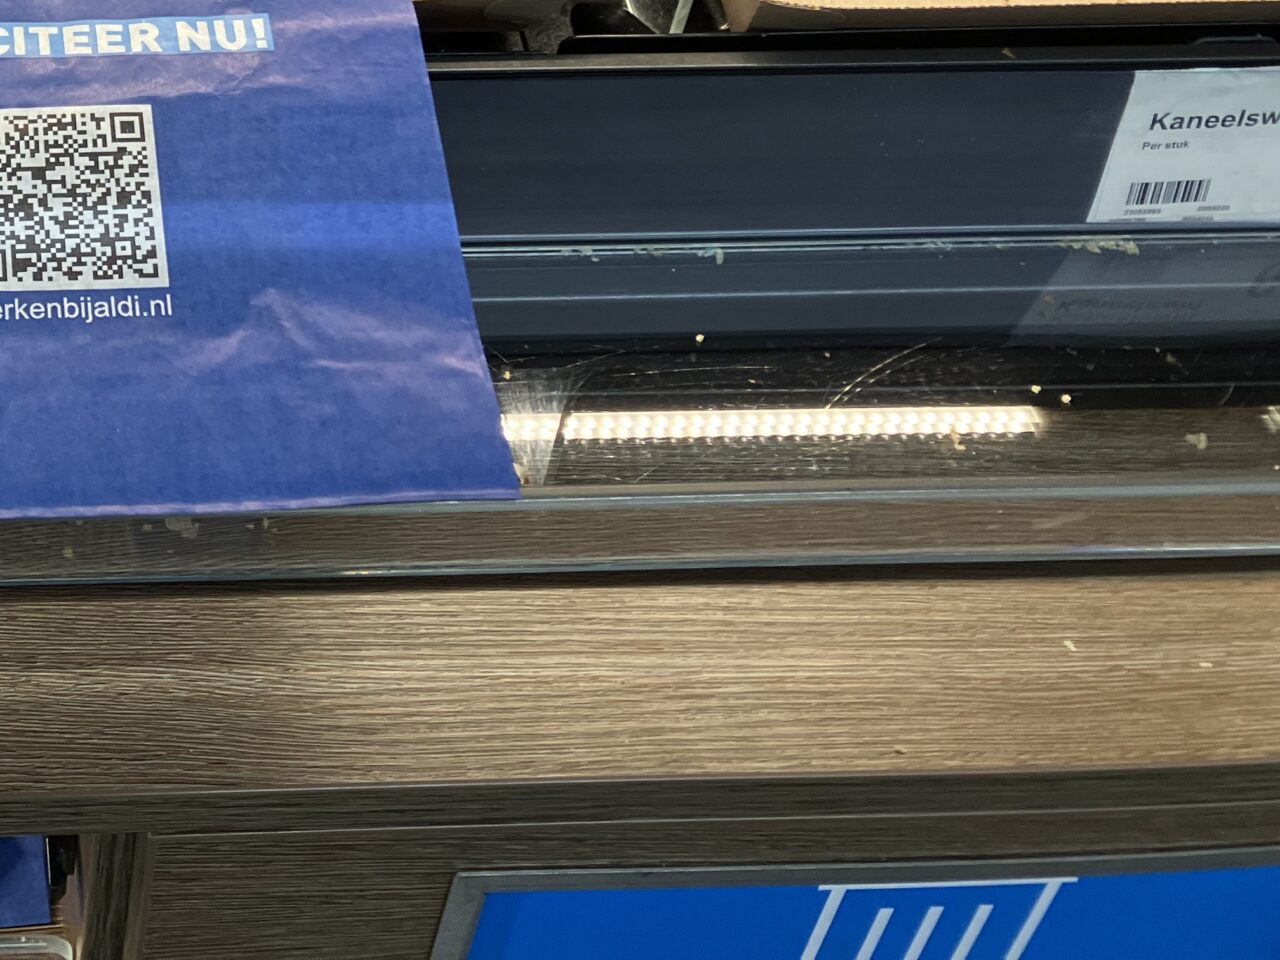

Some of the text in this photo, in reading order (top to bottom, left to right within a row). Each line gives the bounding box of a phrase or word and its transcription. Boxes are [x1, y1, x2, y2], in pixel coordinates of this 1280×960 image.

[176, 18, 269, 52] NU!
[1142, 140, 1190, 150] Per stuk
